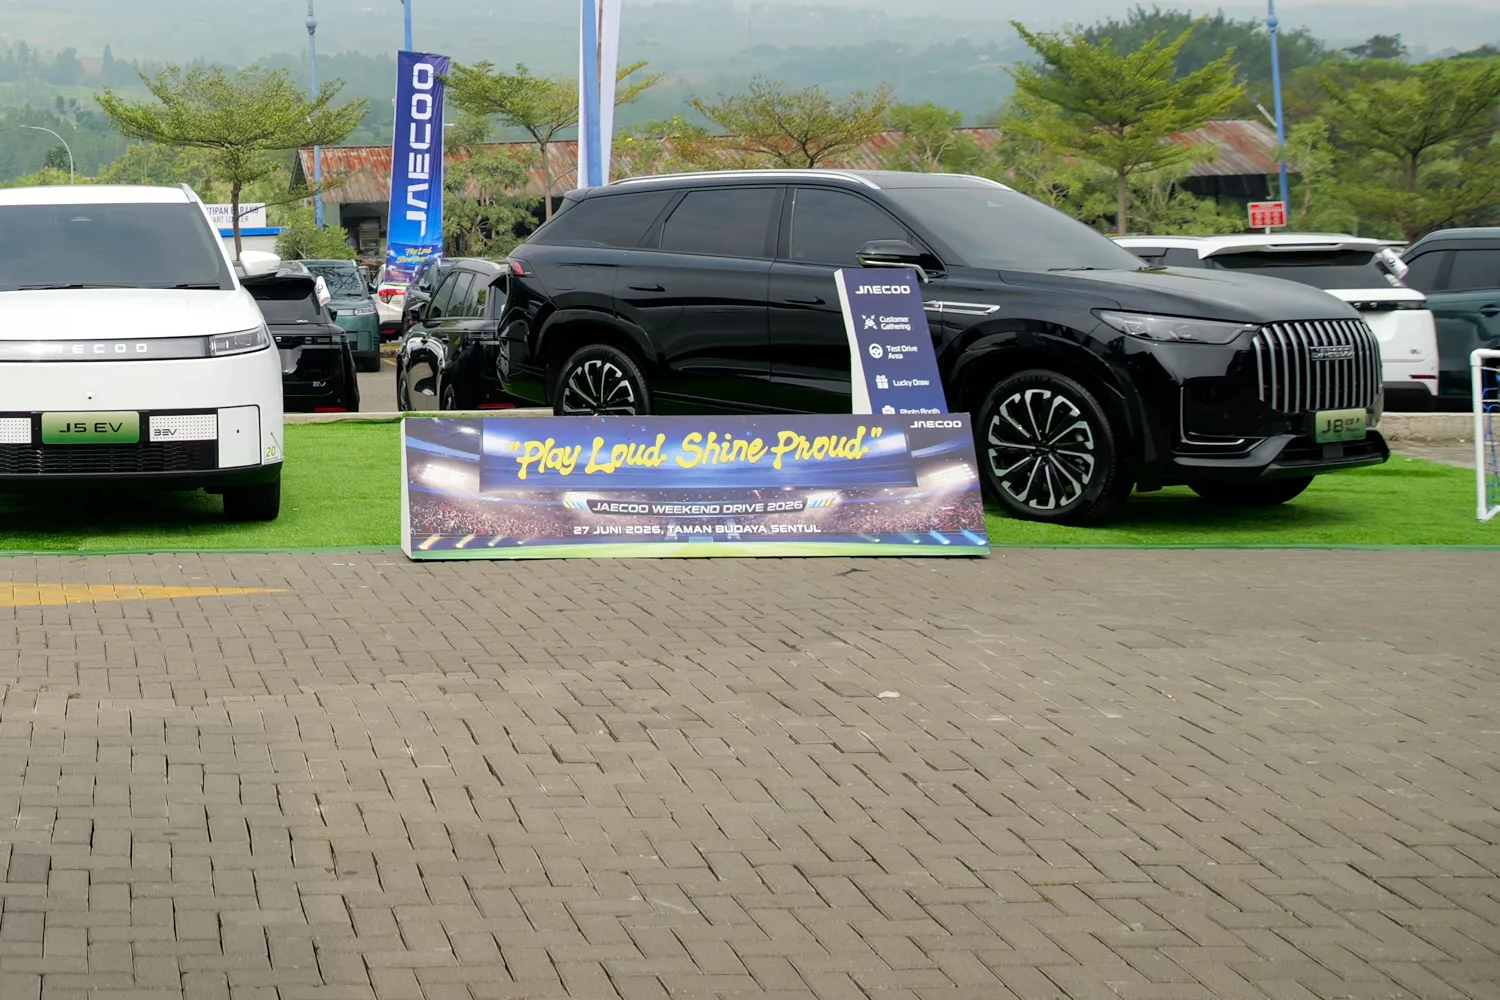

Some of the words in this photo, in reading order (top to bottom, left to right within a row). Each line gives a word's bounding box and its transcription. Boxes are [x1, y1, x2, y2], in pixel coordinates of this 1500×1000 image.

[406, 63, 434, 237] JAECOO
[230, 206, 259, 214] BRANG
[855, 285, 911, 294] JAECOO
[881, 323, 911, 331] Gathering
[52, 343, 147, 354] ECOO
[893, 379, 912, 387] Lucky
[59, 423, 87, 433] J5
[94, 422, 123, 432] EV
[910, 420, 962, 429] JAECOO
[1322, 419, 1343, 433] J8
[675, 431, 768, 469] Shine
[592, 502, 649, 513] JAECOO
[652, 504, 719, 514] WEEKEND
[722, 503, 764, 514] DRIVE
[766, 501, 804, 512] 2026
[573, 526, 589, 535] 27
[593, 526, 622, 535] JUNI
[625, 526, 664, 535] 2026,
[667, 525, 712, 534] TAMAN
[715, 525, 766, 534] BUDAYA
[771, 525, 822, 534] SENTUL
